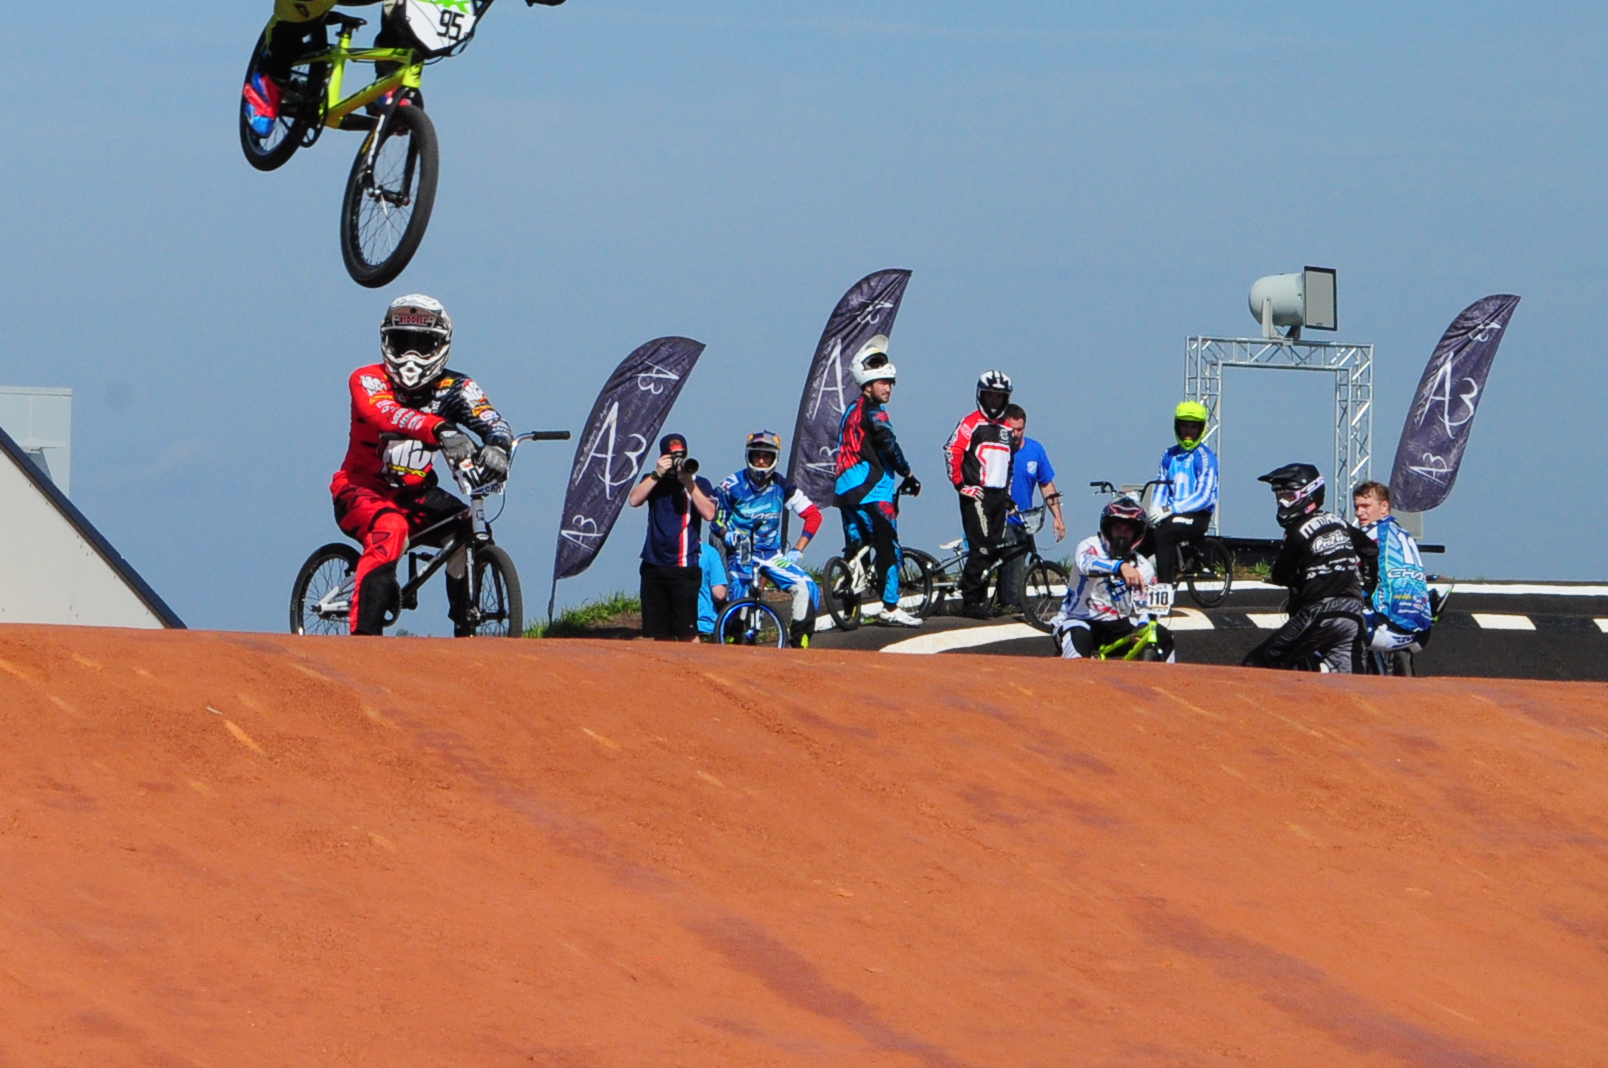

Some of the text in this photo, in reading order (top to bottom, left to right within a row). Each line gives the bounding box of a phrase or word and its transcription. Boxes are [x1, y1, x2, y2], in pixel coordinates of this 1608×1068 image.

[437, 9, 465, 41] 95
[633, 360, 680, 395] A3
[1419, 351, 1478, 439] A3
[575, 400, 647, 501] A3
[1409, 452, 1454, 485] A3
[561, 514, 604, 552] A3
[1149, 591, 1169, 605] 110
